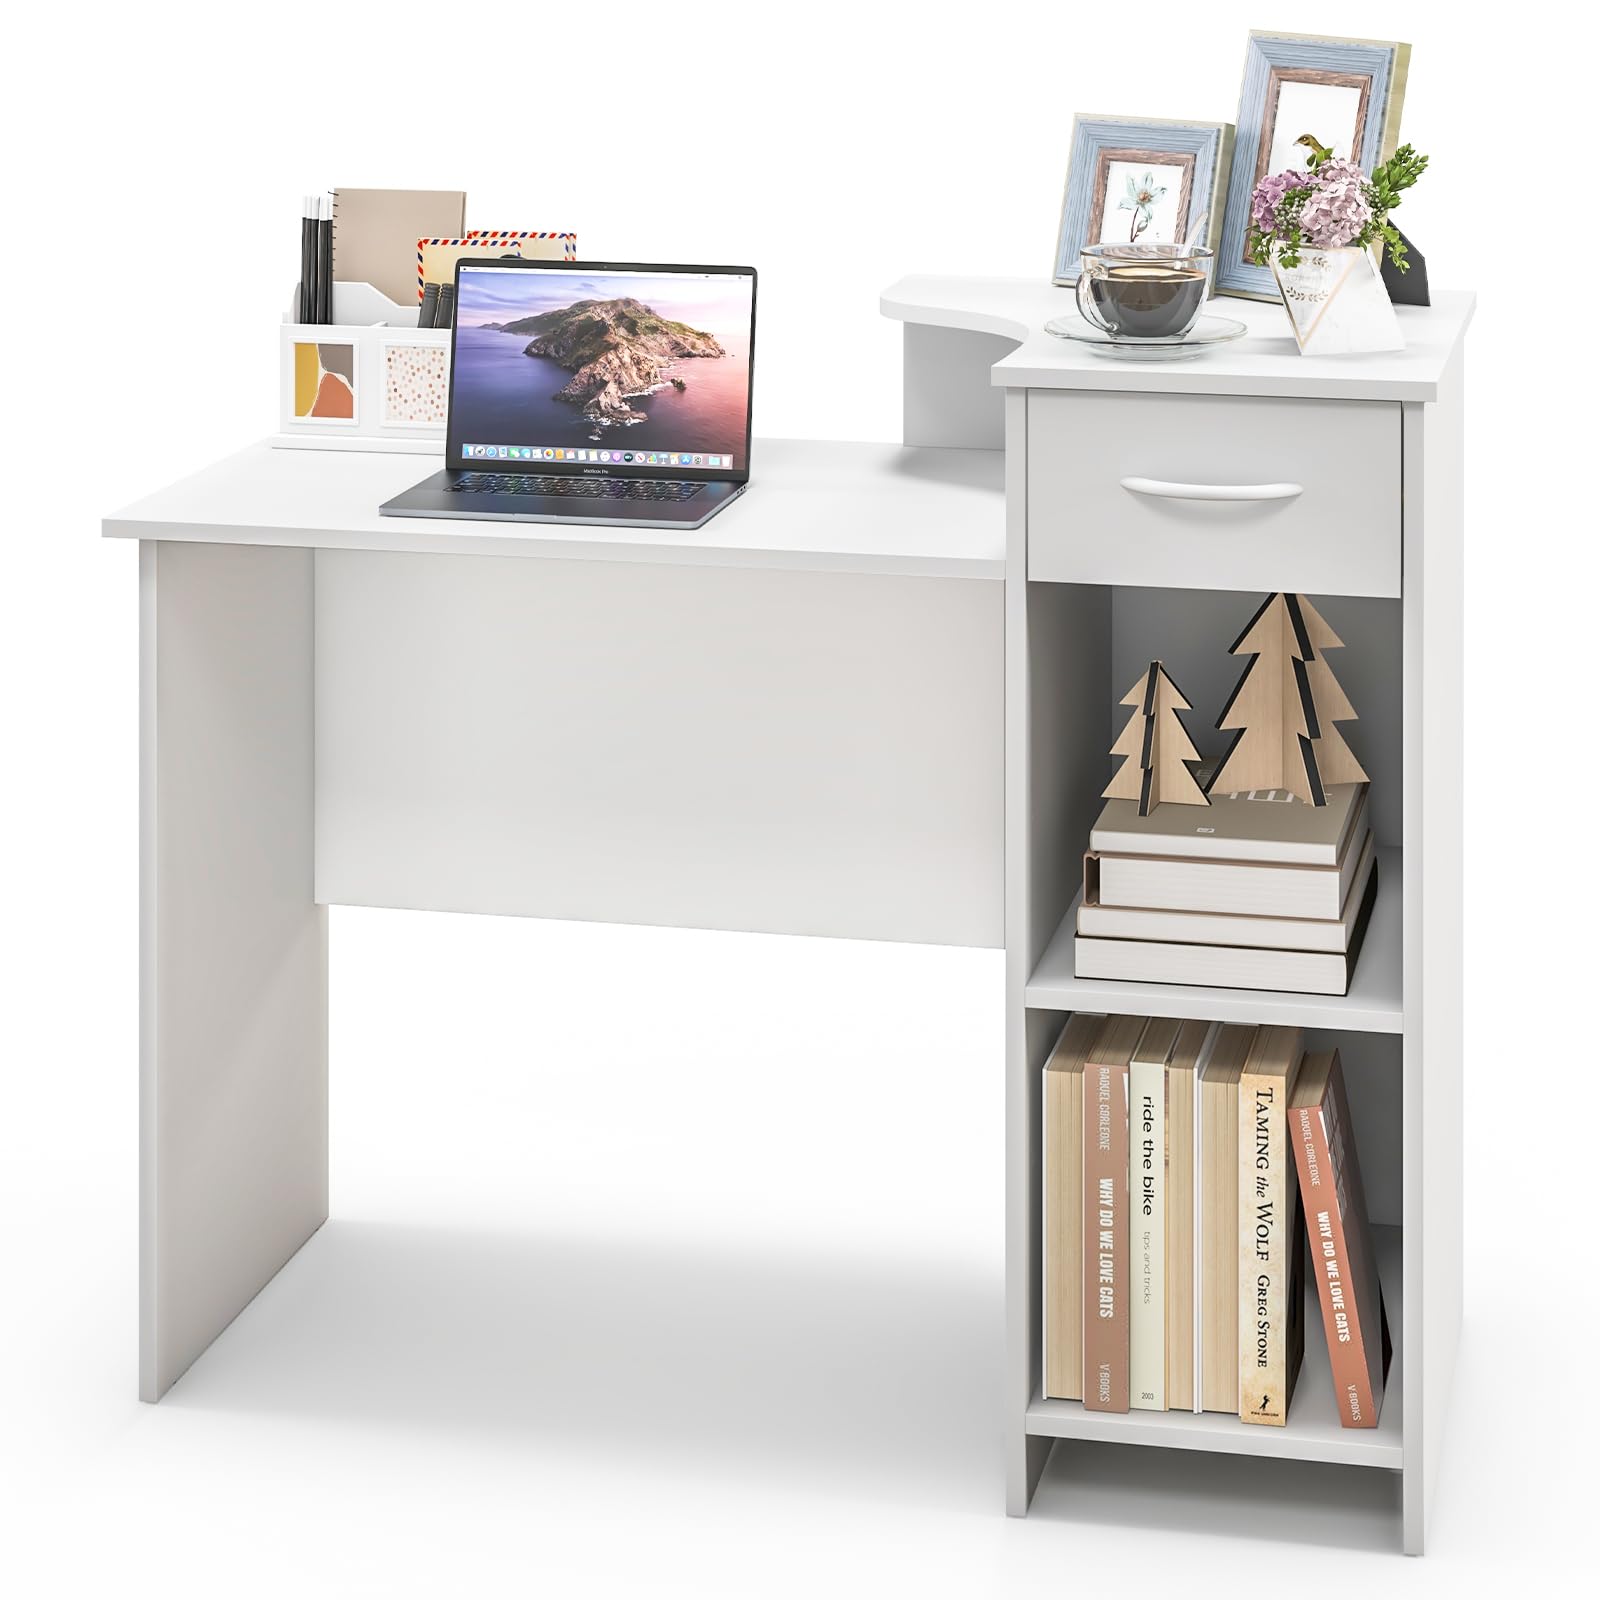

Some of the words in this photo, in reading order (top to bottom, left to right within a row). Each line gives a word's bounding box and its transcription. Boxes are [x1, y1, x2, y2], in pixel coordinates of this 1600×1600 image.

[1100, 1104, 1110, 1151] CORLEONE
[1143, 1096, 1154, 1132] ride
[1256, 1087, 1273, 1170] TAMING
[1143, 1139, 1154, 1169] the
[1305, 1143, 1320, 1186] CORLEONE
[1100, 1178, 1113, 1207] WHY
[1143, 1176, 1154, 1216] bike
[1256, 1176, 1269, 1198] the
[1100, 1210, 1113, 1227] DO
[1256, 1202, 1273, 1261] WOLF
[1317, 1211, 1332, 1238] WHY
[1100, 1231, 1113, 1249] WE
[1143, 1231, 1151, 1250] tips
[1322, 1241, 1335, 1258] DO
[1100, 1253, 1113, 1283] LOVE
[1326, 1260, 1339, 1279] WE
[1100, 1286, 1113, 1318] CATS
[1257, 1274, 1270, 1316] GREG
[1329, 1281, 1345, 1310] LOVE
[1335, 1312, 1350, 1343] CATS
[1257, 1320, 1270, 1368] STONE
[1100, 1372, 1110, 1403] BOOKS
[1347, 1384, 1356, 1392] V
[1349, 1392, 1361, 1421] BOOKS
